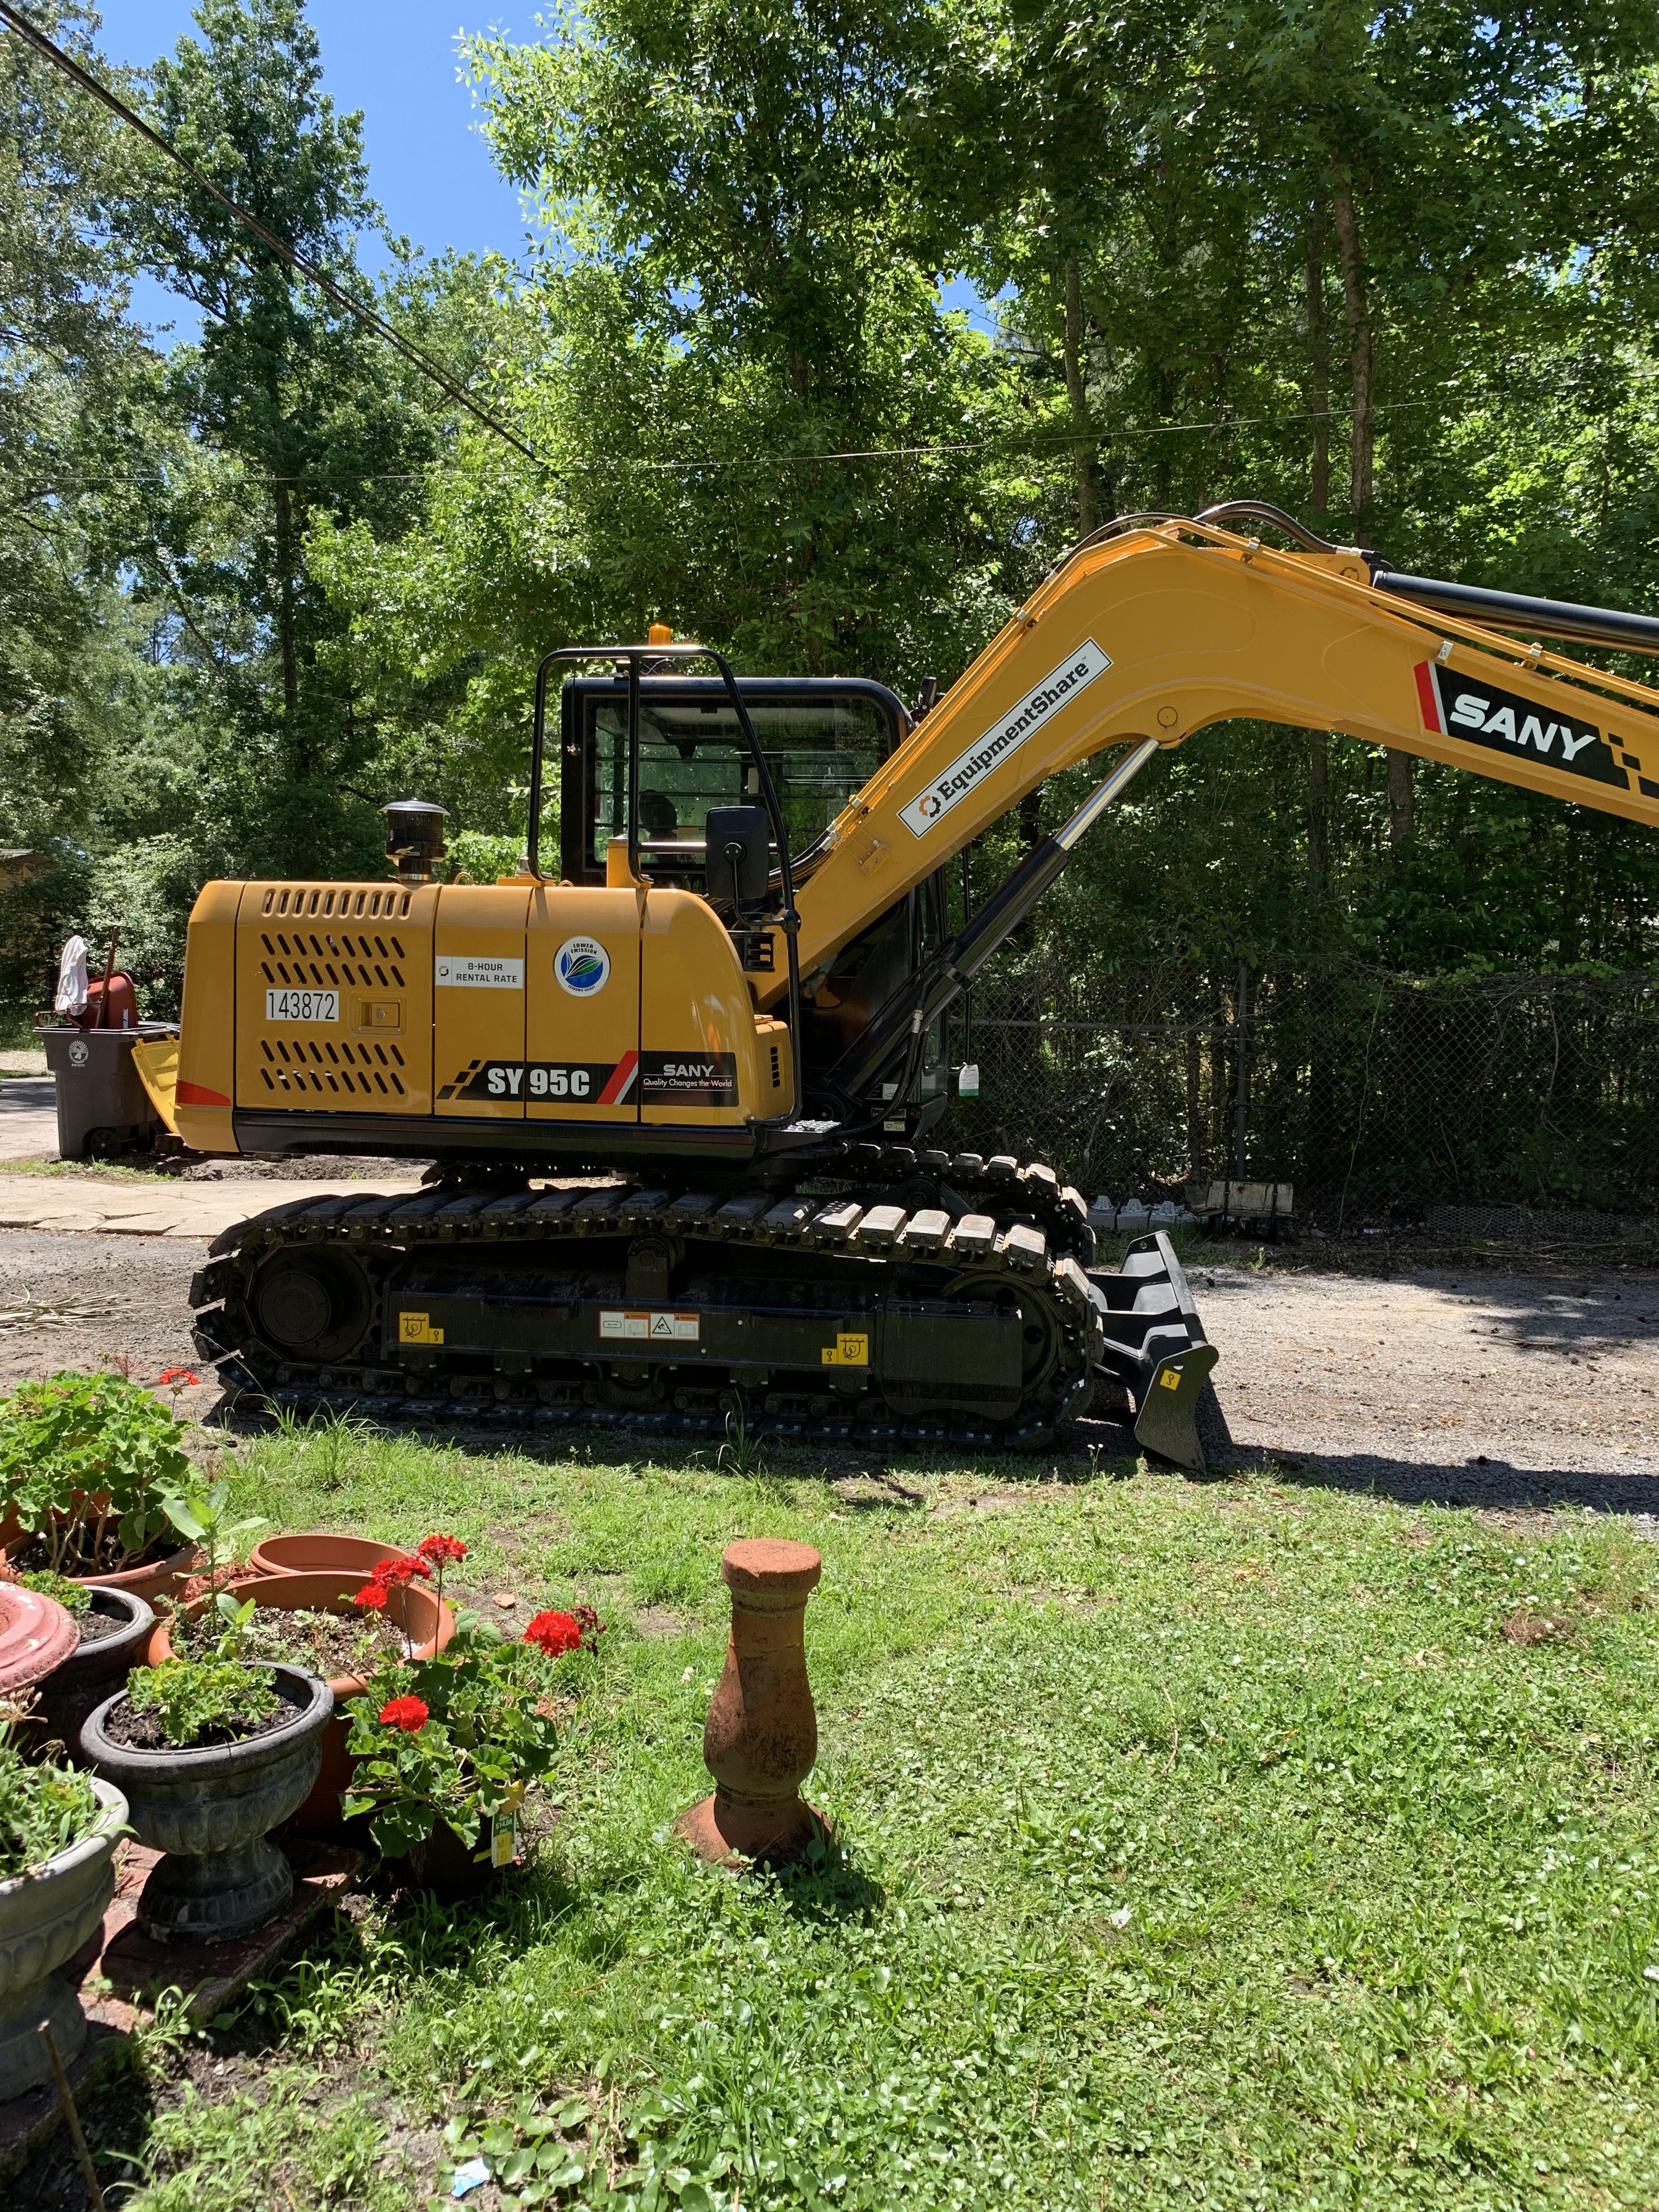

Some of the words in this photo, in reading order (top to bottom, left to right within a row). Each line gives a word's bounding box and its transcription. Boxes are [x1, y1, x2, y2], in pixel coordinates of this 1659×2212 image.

[937, 662, 1089, 800] EquipmentShare
[1449, 694, 1596, 761] SANY
[269, 992, 335, 1019] 143872
[643, 1078, 668, 1087] Quality
[669, 1079, 697, 1088] Changes
[710, 1079, 732, 1087] World
[663, 1064, 714, 1077] SANY
